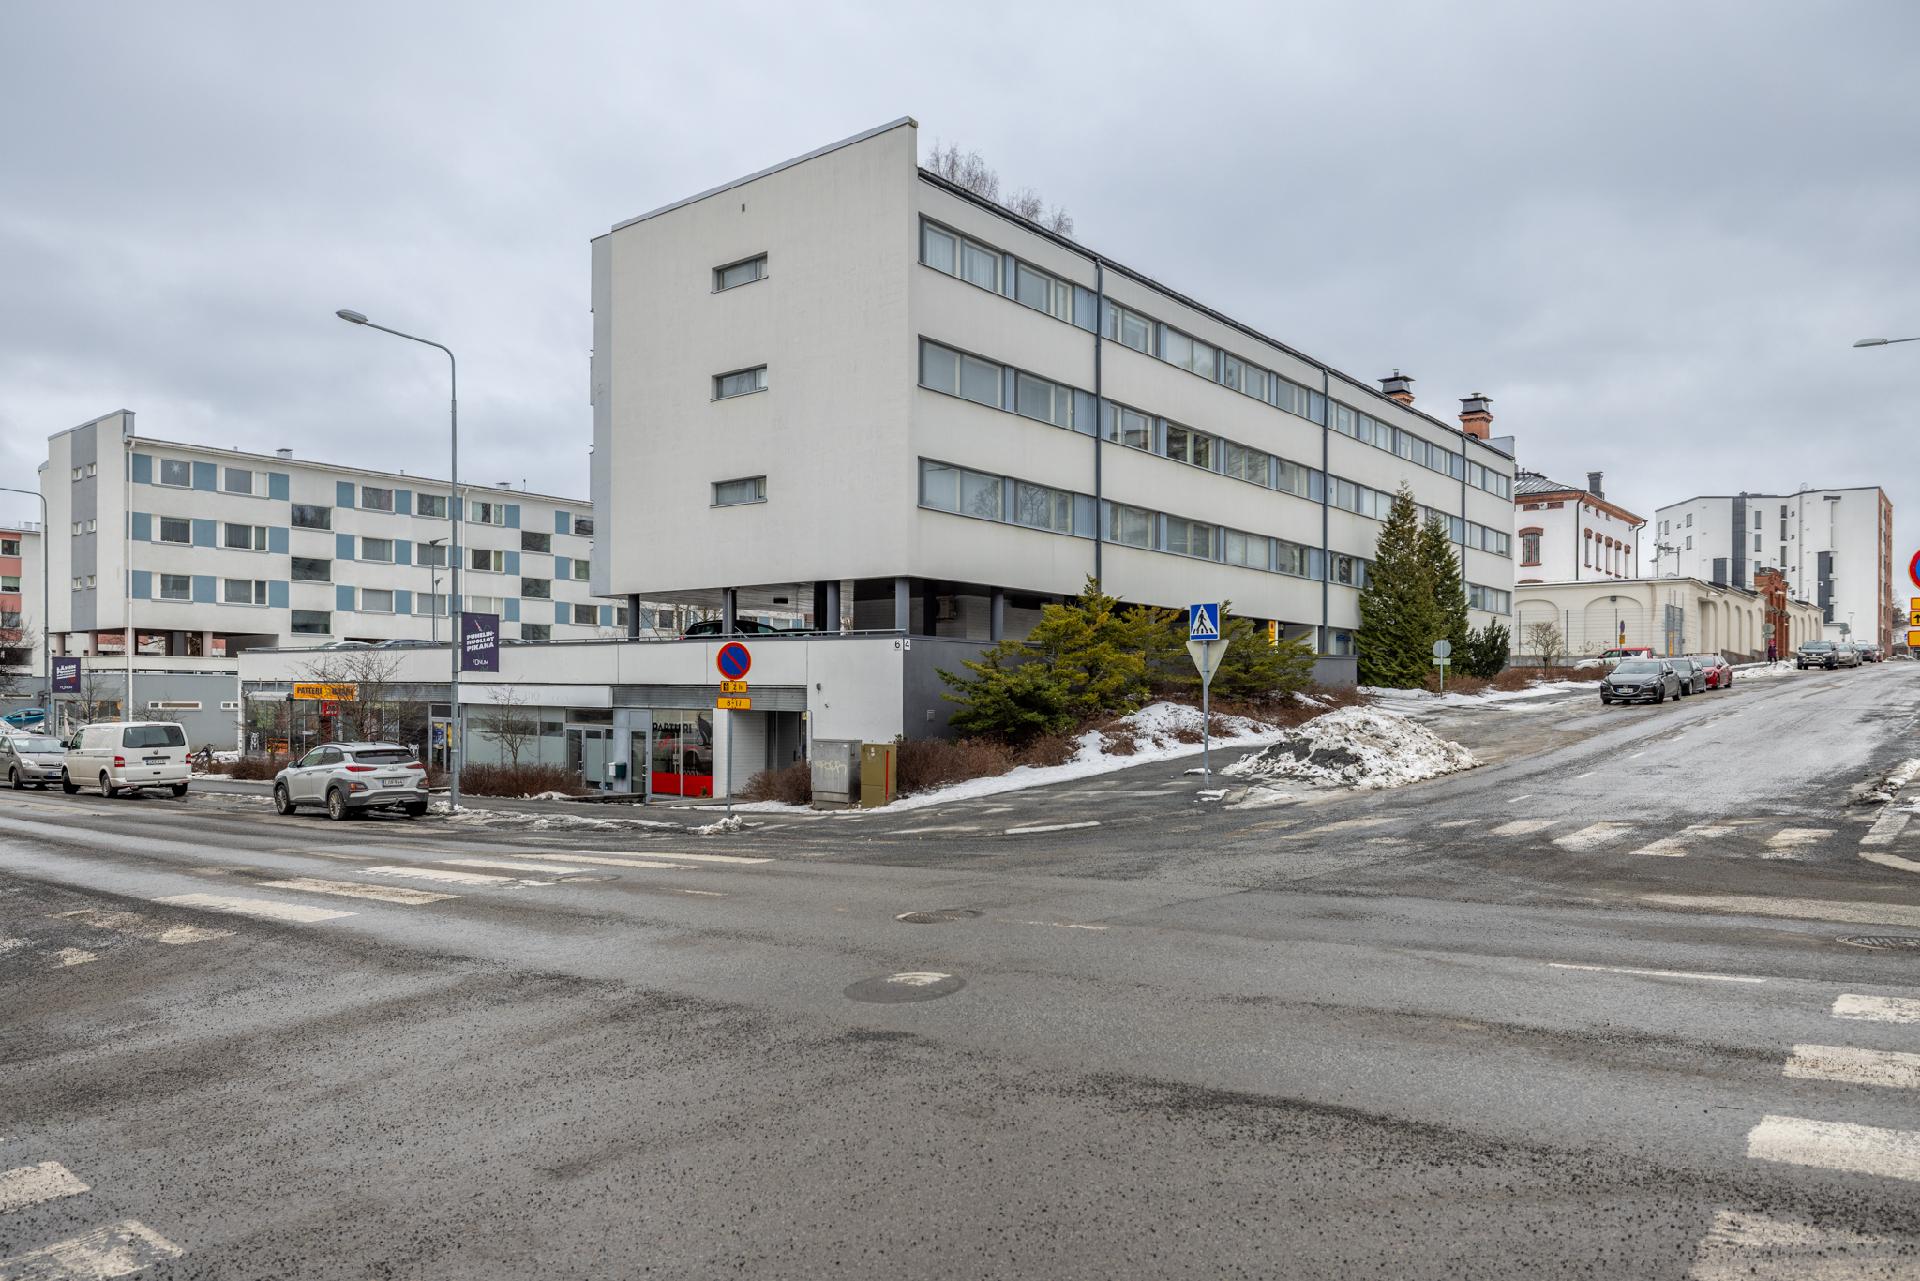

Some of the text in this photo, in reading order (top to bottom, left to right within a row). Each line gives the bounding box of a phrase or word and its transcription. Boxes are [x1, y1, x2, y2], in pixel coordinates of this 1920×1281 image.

[894, 640, 901, 649] 6
[732, 683, 737, 691] 2
[652, 722, 693, 734] PARTURI
